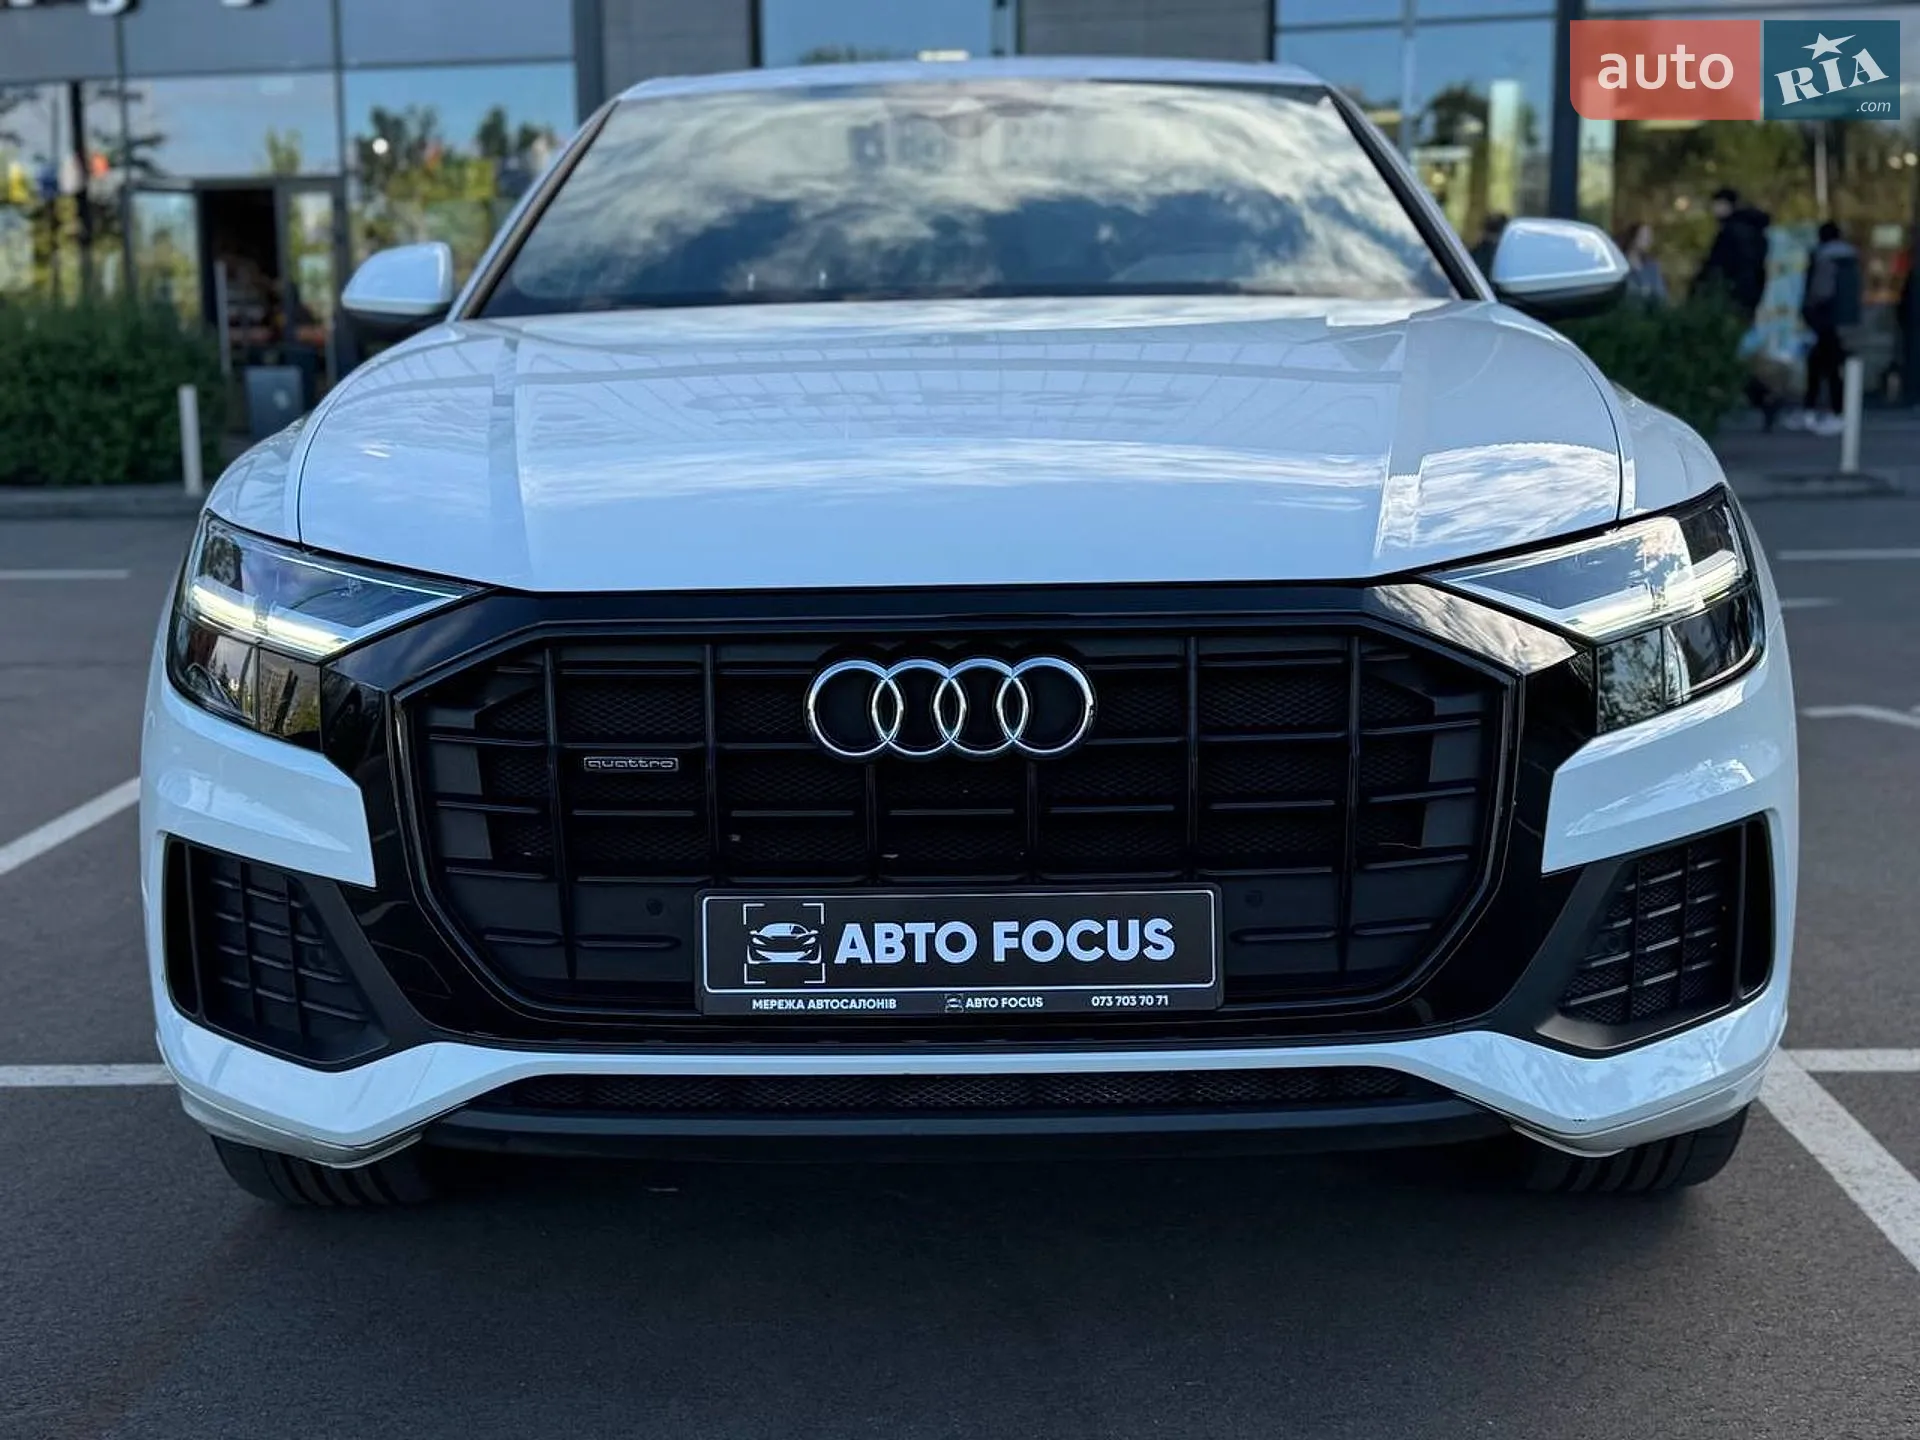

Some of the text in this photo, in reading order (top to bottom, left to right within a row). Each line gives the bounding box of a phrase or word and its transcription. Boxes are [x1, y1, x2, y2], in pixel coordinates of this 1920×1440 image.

[587, 760, 674, 769] quattro
[834, 917, 1176, 964] АВТО FOCUS
[752, 998, 897, 1010] МЕРЕЖА АВТОСАЛОНІВ
[965, 996, 1044, 1008] АВТО FOCUS
[1091, 995, 1169, 1007] 073 703 70 71
